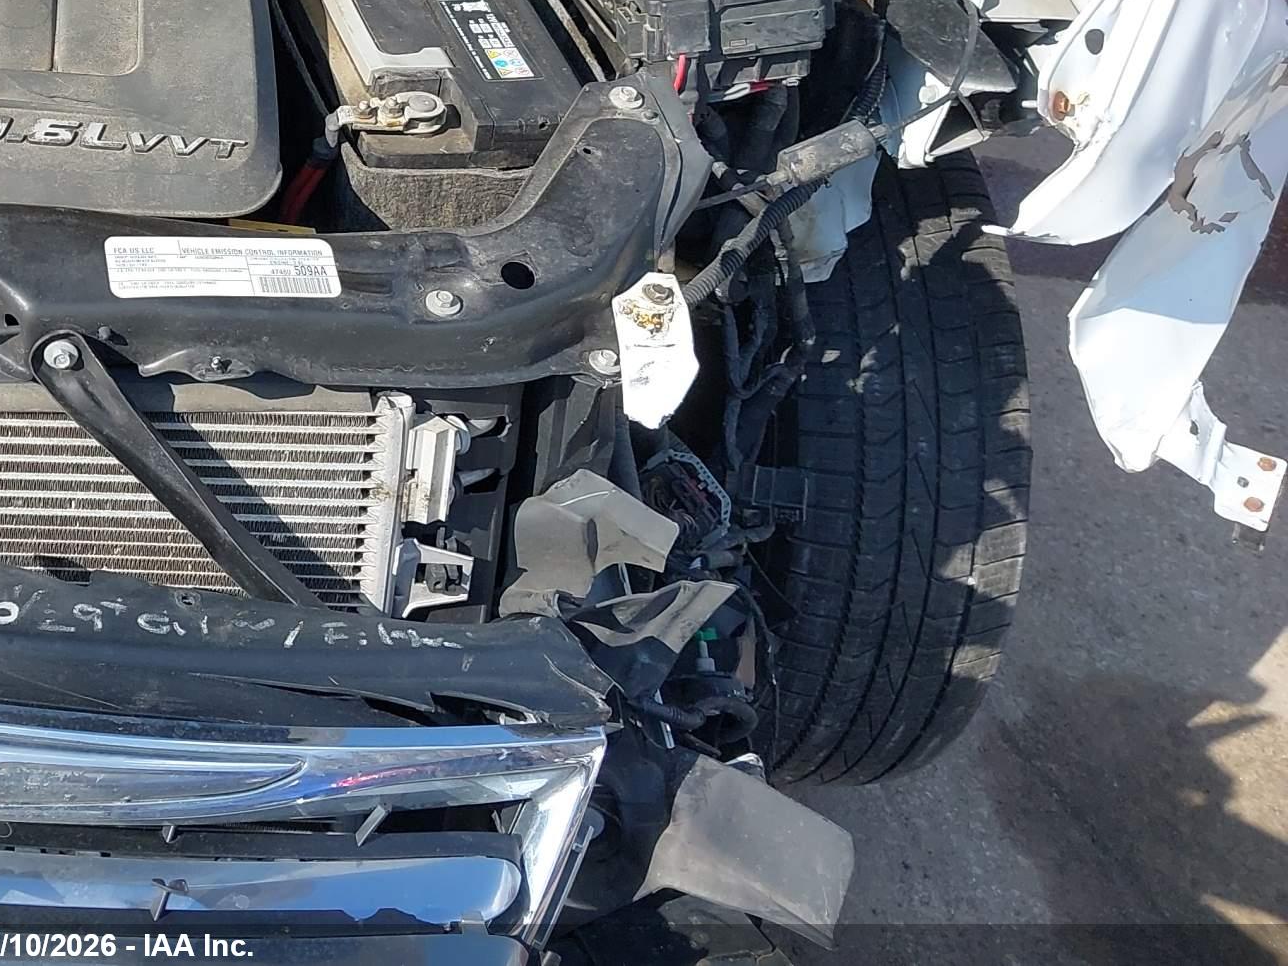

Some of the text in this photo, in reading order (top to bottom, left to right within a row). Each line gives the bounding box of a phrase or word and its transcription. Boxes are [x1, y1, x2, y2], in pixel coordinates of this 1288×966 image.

[181, 247, 209, 255] VEHICLE
[244, 248, 274, 256] CONTROL
[294, 265, 328, 276] 509AA
